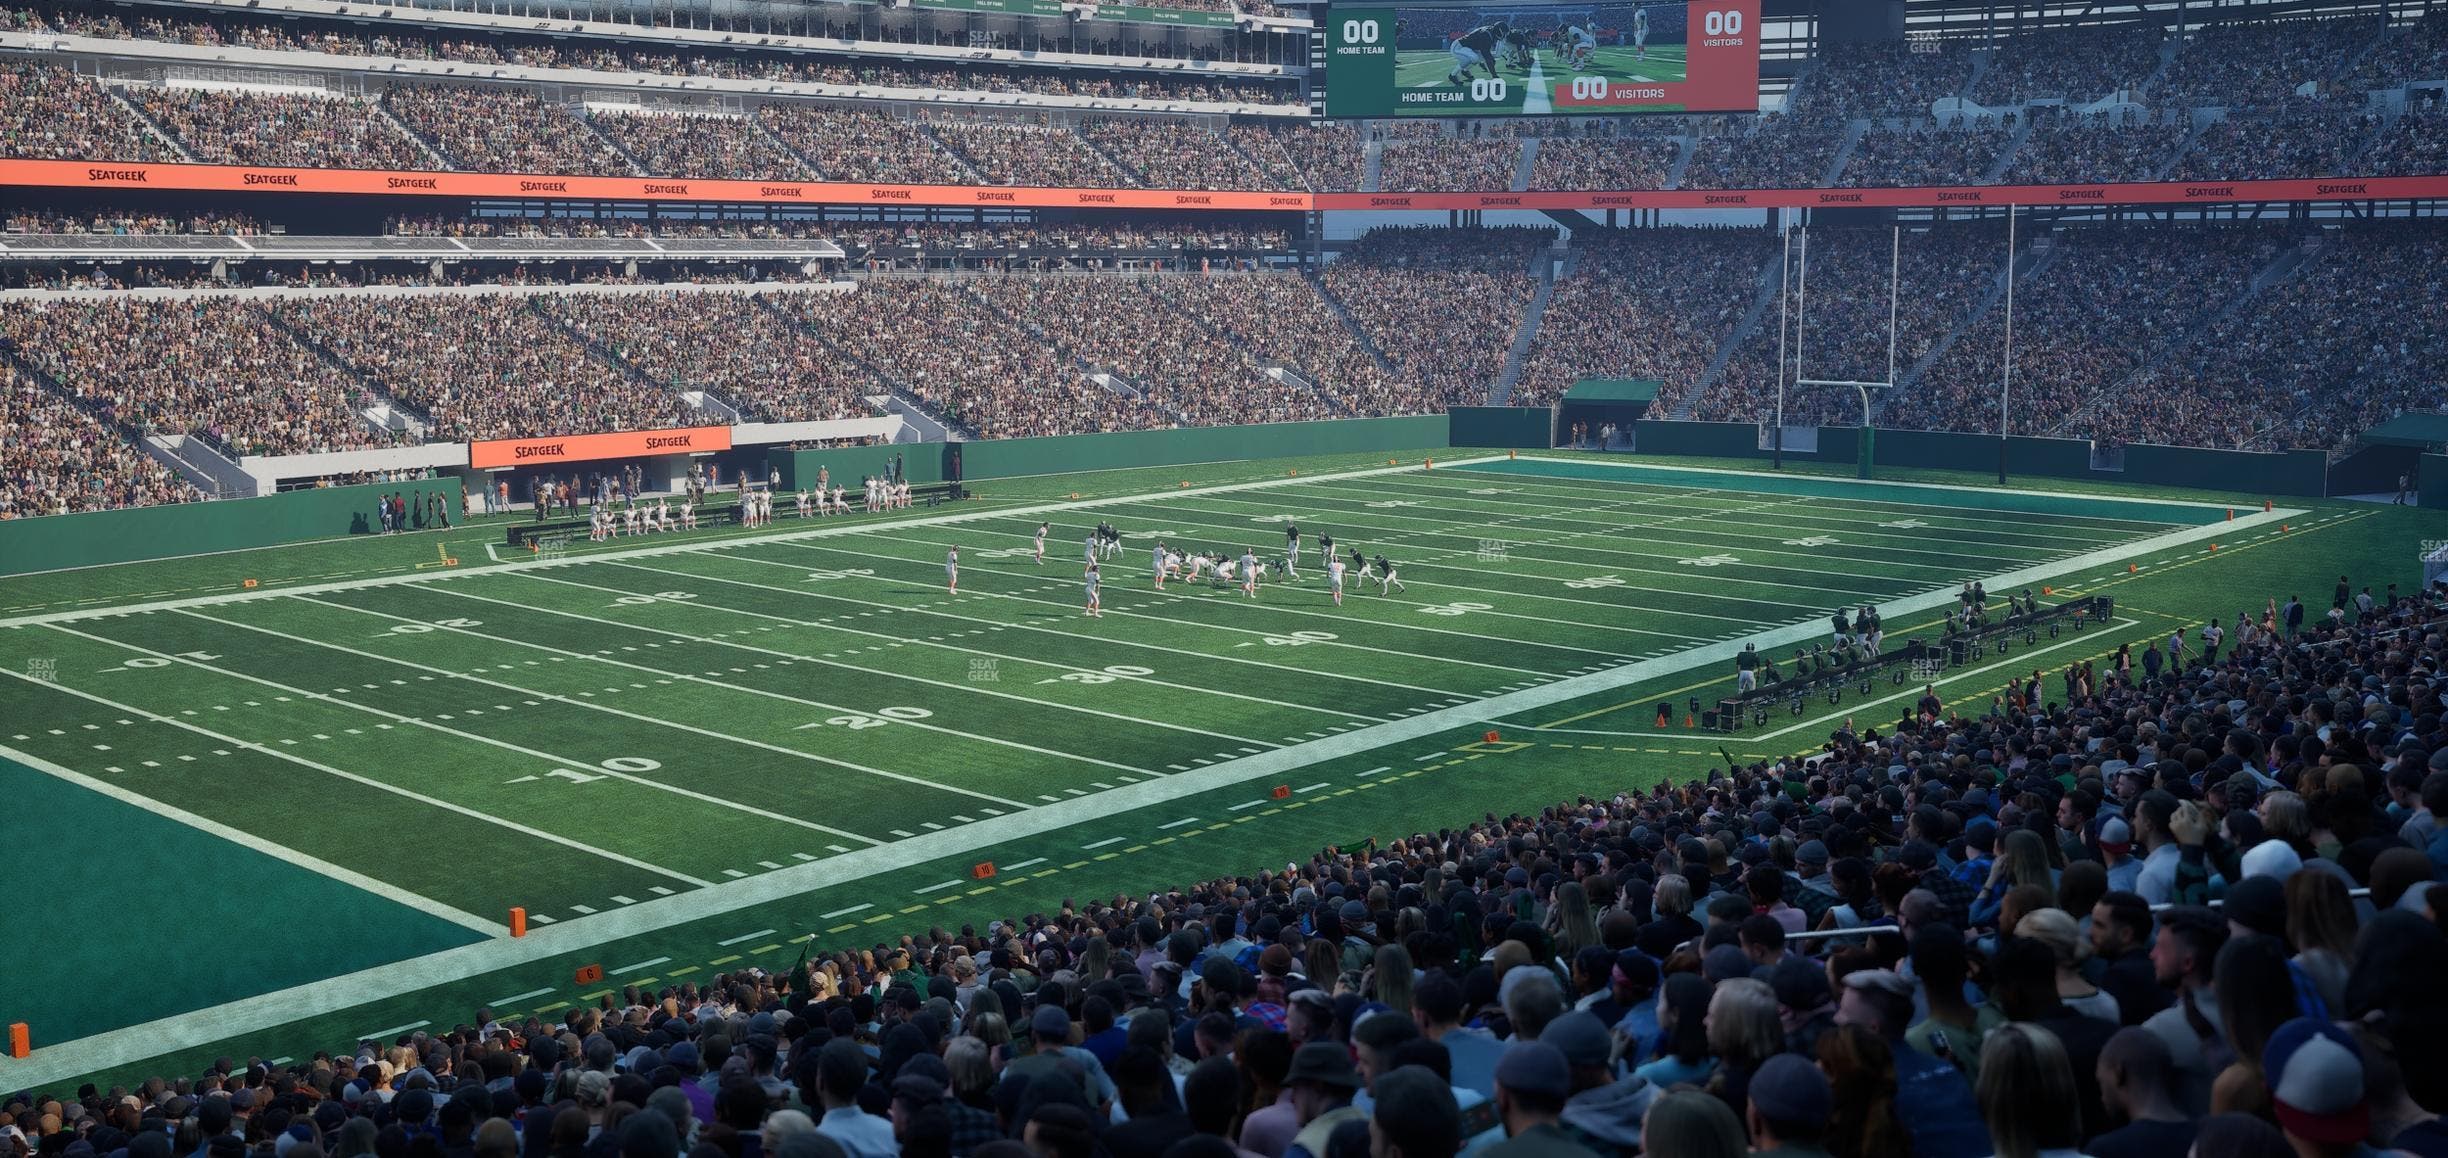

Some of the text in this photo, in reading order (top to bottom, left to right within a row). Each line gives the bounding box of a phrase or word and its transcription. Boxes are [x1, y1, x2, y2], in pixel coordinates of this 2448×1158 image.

[1705, 10, 1742, 35] 00
[1343, 20, 1379, 43] 00
[1704, 38, 1743, 47] VISITORS
[1402, 78, 1506, 102] HOME TEAM 00
[1572, 76, 1665, 100] 00 VISITORS
[89, 169, 147, 181] SEATGEEK
[244, 173, 298, 186] SEATGEEK
[388, 178, 437, 189] SEATGEEK
[521, 181, 566, 192] SEATGEEK
[644, 184, 687, 194] SEATGEEK
[761, 187, 801, 197] SEATGEEK
[872, 189, 911, 199] SEATGEEK
[2185, 187, 2234, 197] SEATGEEK
[2317, 184, 2367, 194] SEATGEEK
[977, 192, 1015, 201] SEATGEEK
[1079, 194, 1115, 203] SEATGEEK
[1705, 195, 1746, 204] SEATGEEK
[1820, 194, 1862, 202] SEATGEEK
[1938, 192, 1981, 201] SEATGEEK
[2060, 190, 2104, 200] SEATGEEK
[515, 435, 691, 458] SEATGEEK SEATGEEK
[1061, 665, 1155, 684] 30
[825, 706, 934, 730] 20
[544, 757, 662, 784] 10
